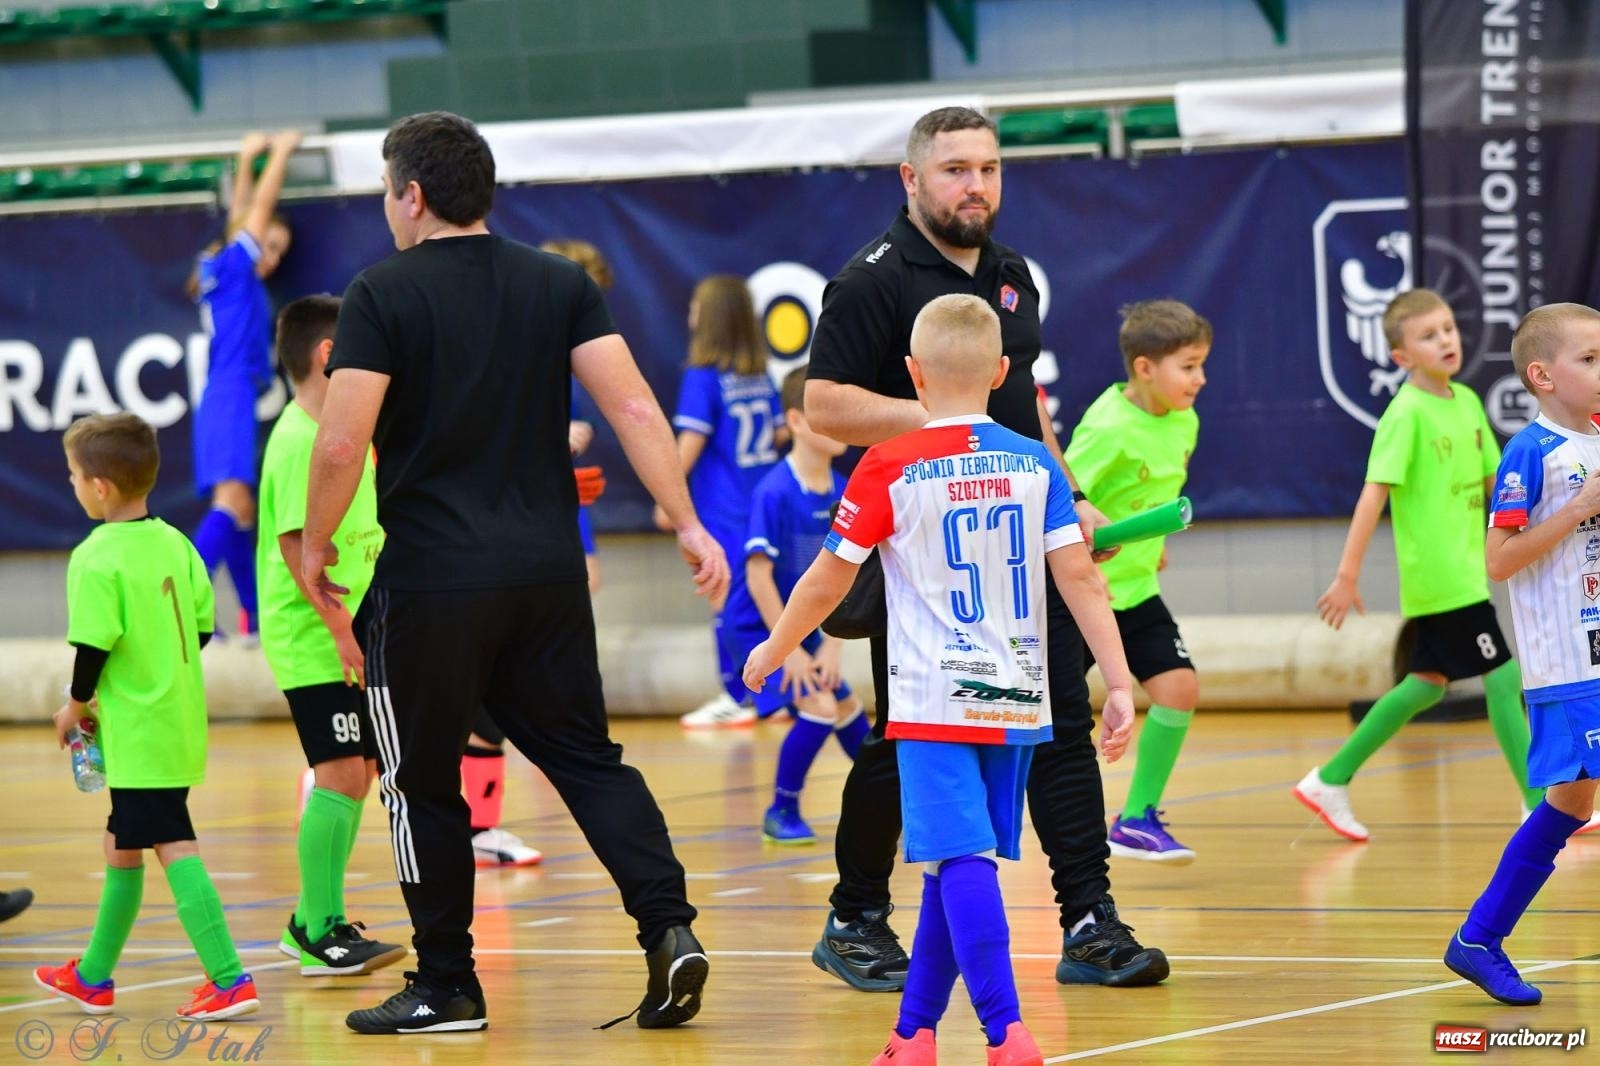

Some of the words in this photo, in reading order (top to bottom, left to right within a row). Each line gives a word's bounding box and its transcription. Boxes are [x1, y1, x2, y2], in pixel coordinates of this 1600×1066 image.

[1481, 137, 1518, 331] JUNIOR
[729, 400, 779, 468] 22
[903, 456, 956, 485] SPÓJNIA
[942, 503, 1029, 624] 57
[162, 576, 189, 665] 1
[1476, 632, 1497, 660] 8
[332, 711, 361, 743] 99
